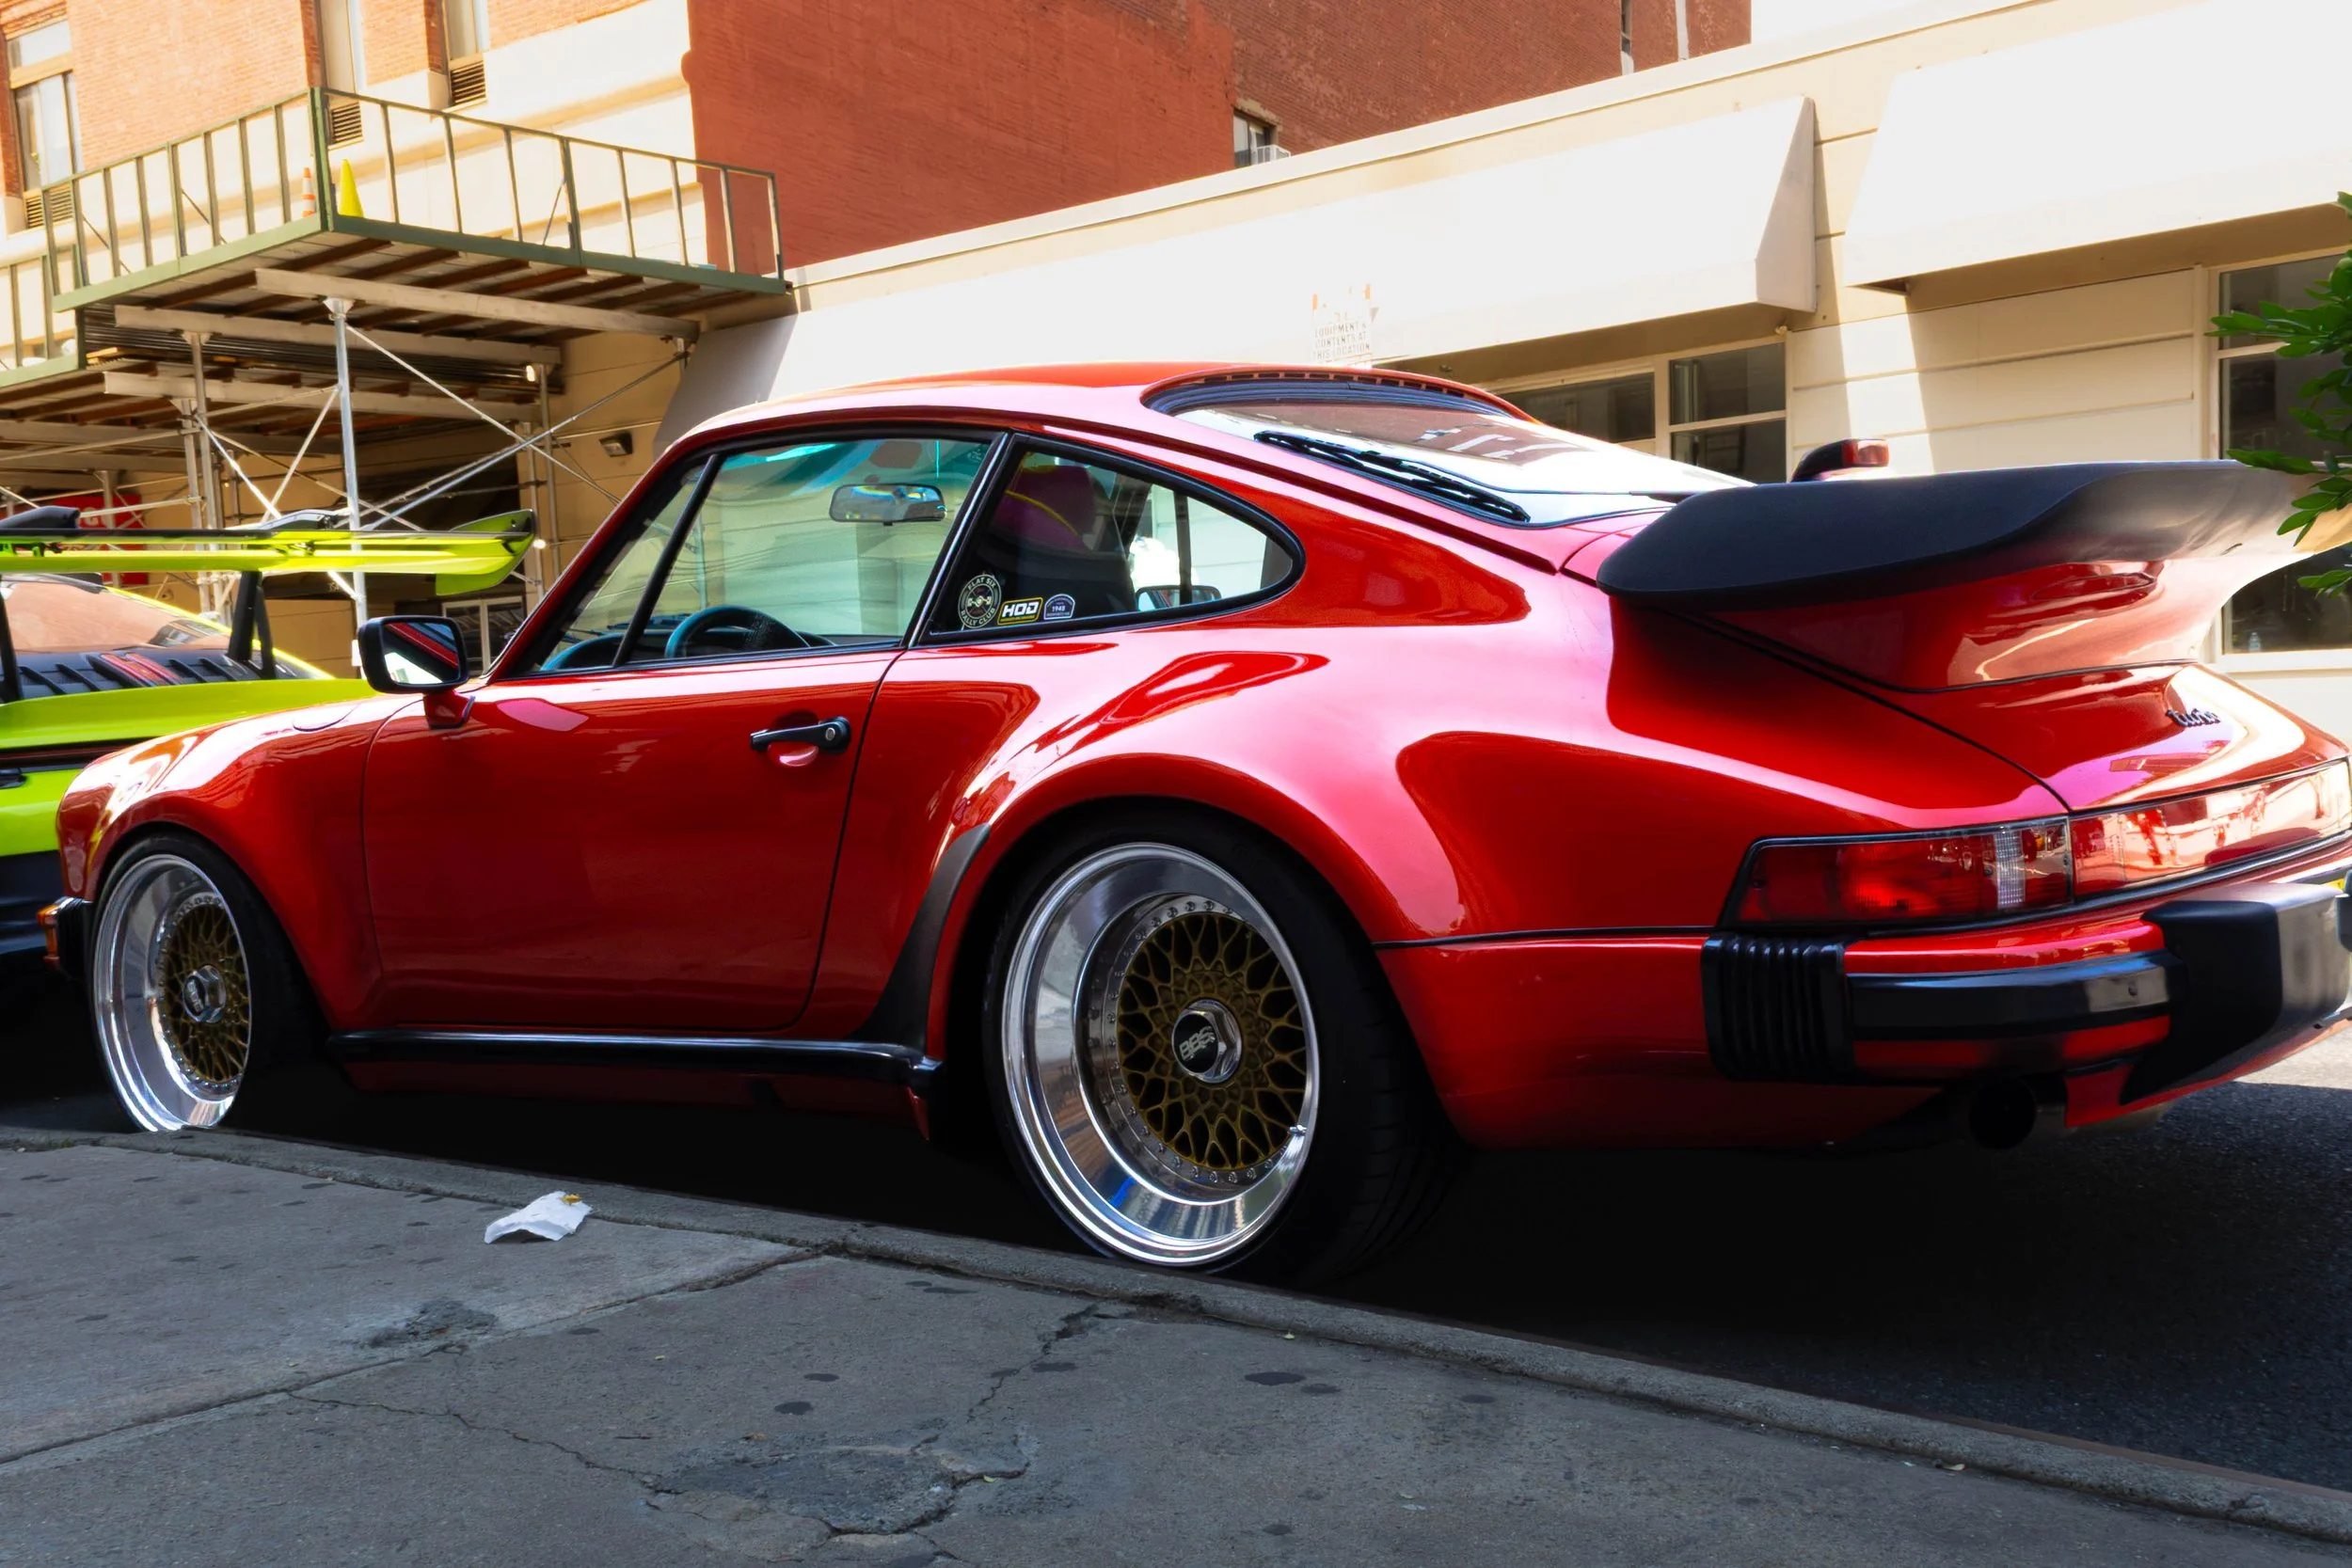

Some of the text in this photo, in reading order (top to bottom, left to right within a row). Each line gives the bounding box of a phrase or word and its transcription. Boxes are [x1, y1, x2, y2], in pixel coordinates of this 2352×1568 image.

[1315, 321, 1359, 338] EQUIPMENT
[1315, 333, 1356, 348] CONTENTS
[1311, 342, 1370, 361] THIS LOCATION
[967, 578, 996, 589] FLAT SIX
[961, 608, 995, 626] RALLY CLUB
[1179, 1025, 1216, 1061] BBS
